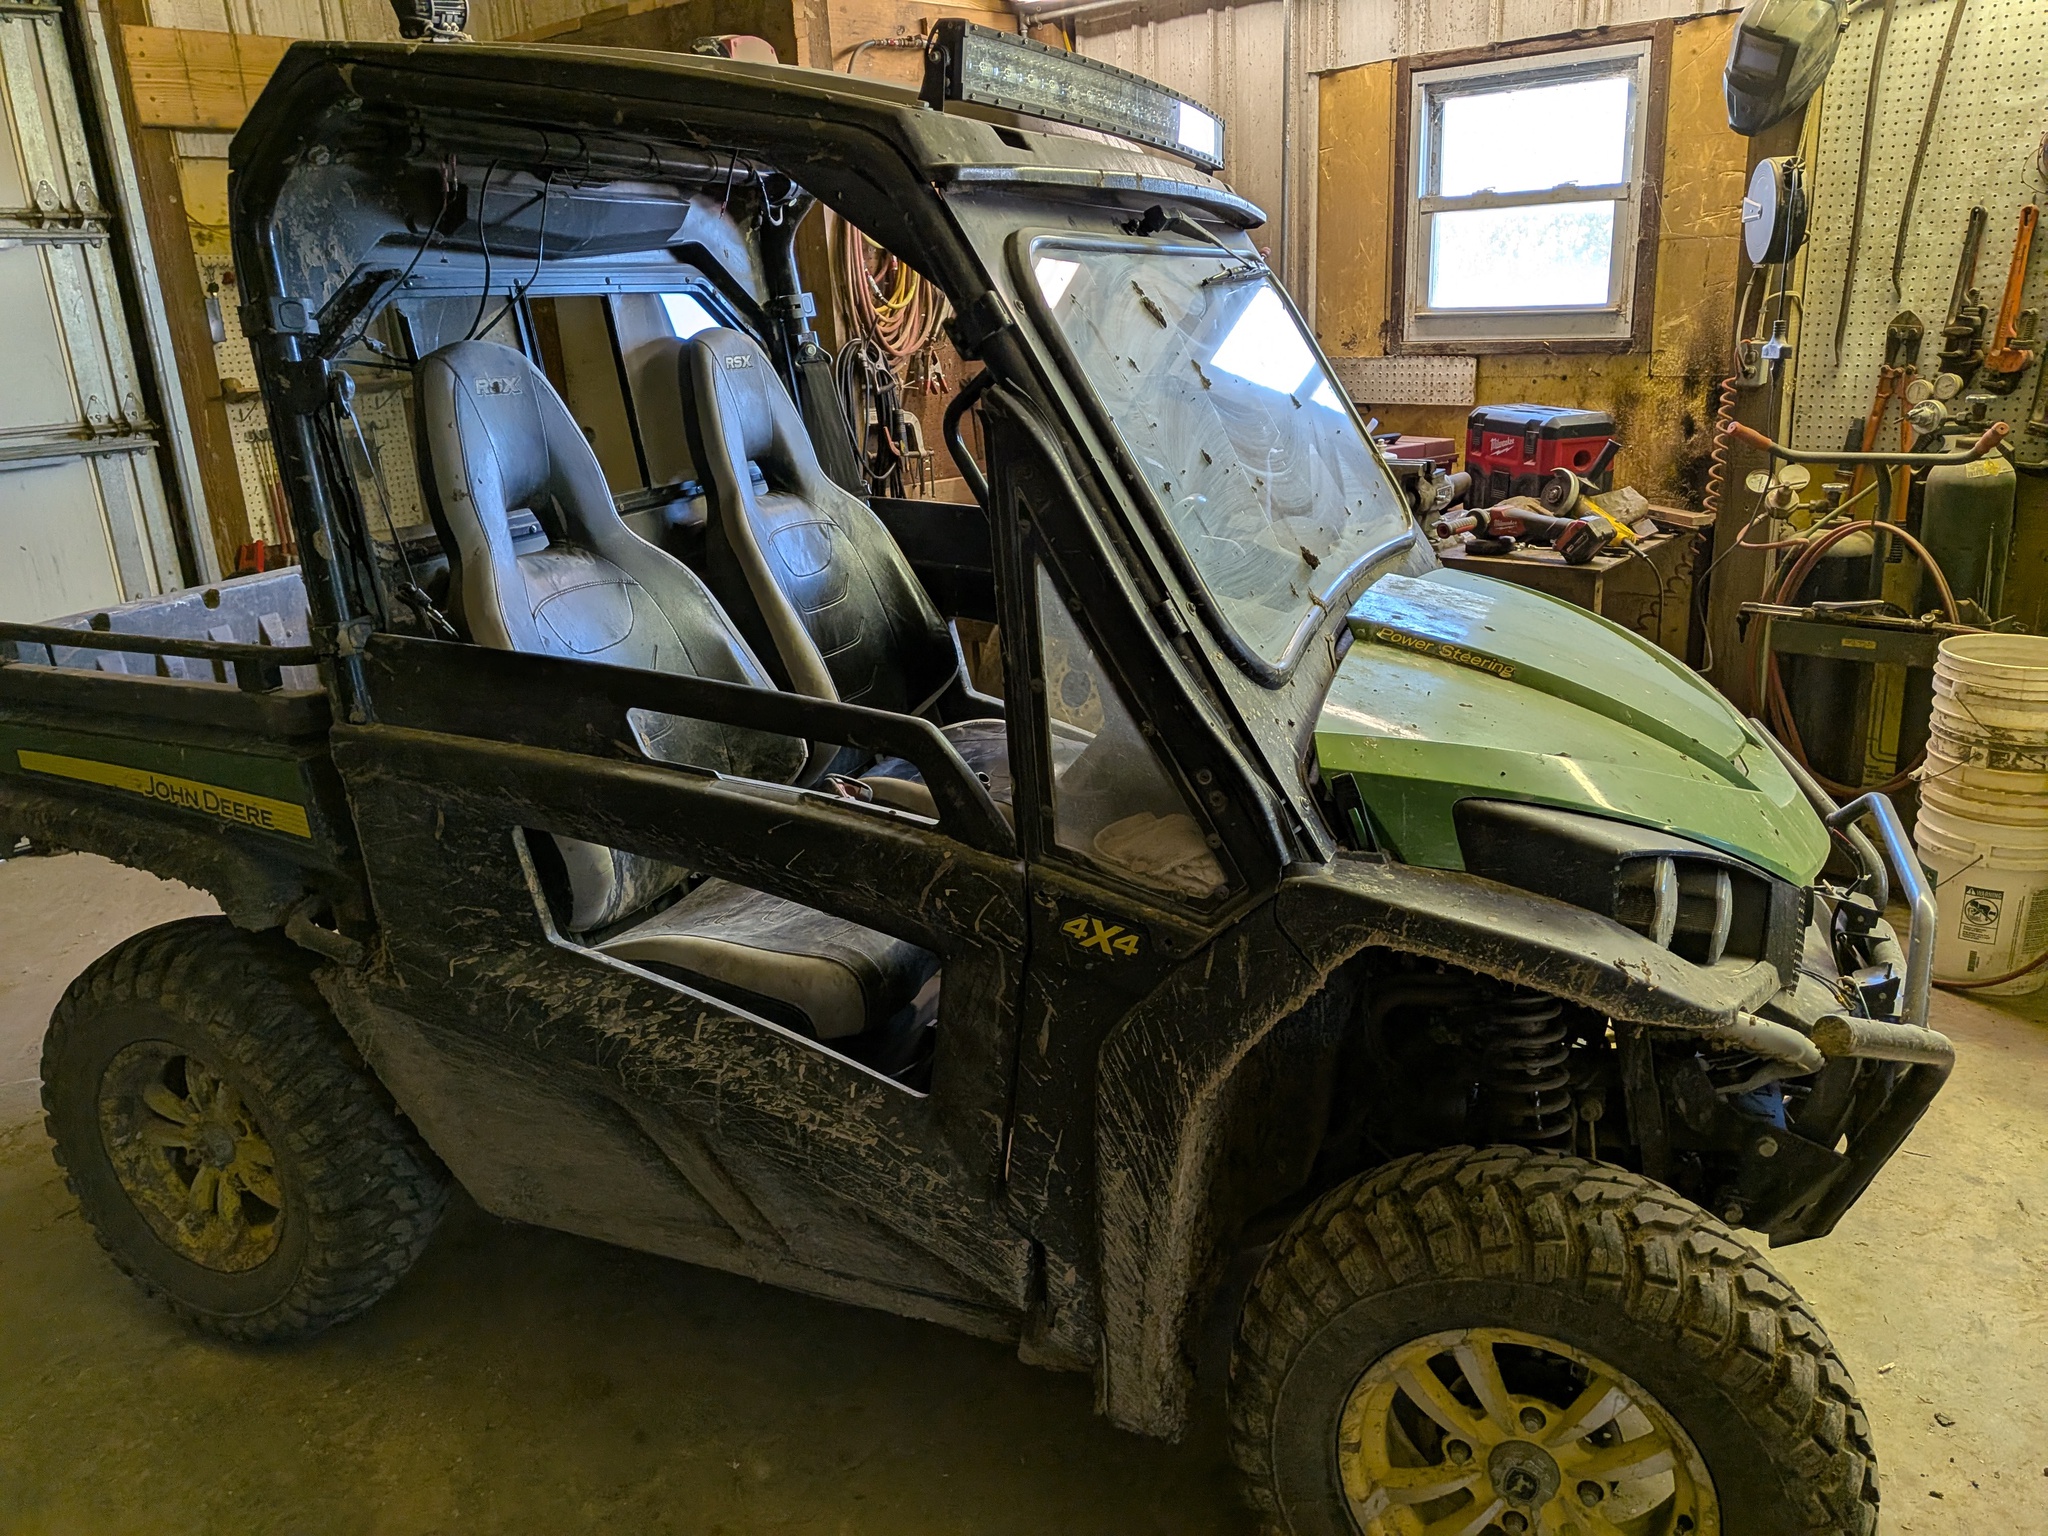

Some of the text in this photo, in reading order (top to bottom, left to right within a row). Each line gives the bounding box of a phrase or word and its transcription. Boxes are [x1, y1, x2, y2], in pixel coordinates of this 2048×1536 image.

[725, 355, 752, 369] RSX
[1376, 627, 1516, 678] Power Steering
[145, 776, 275, 828] JOHN DEERE
